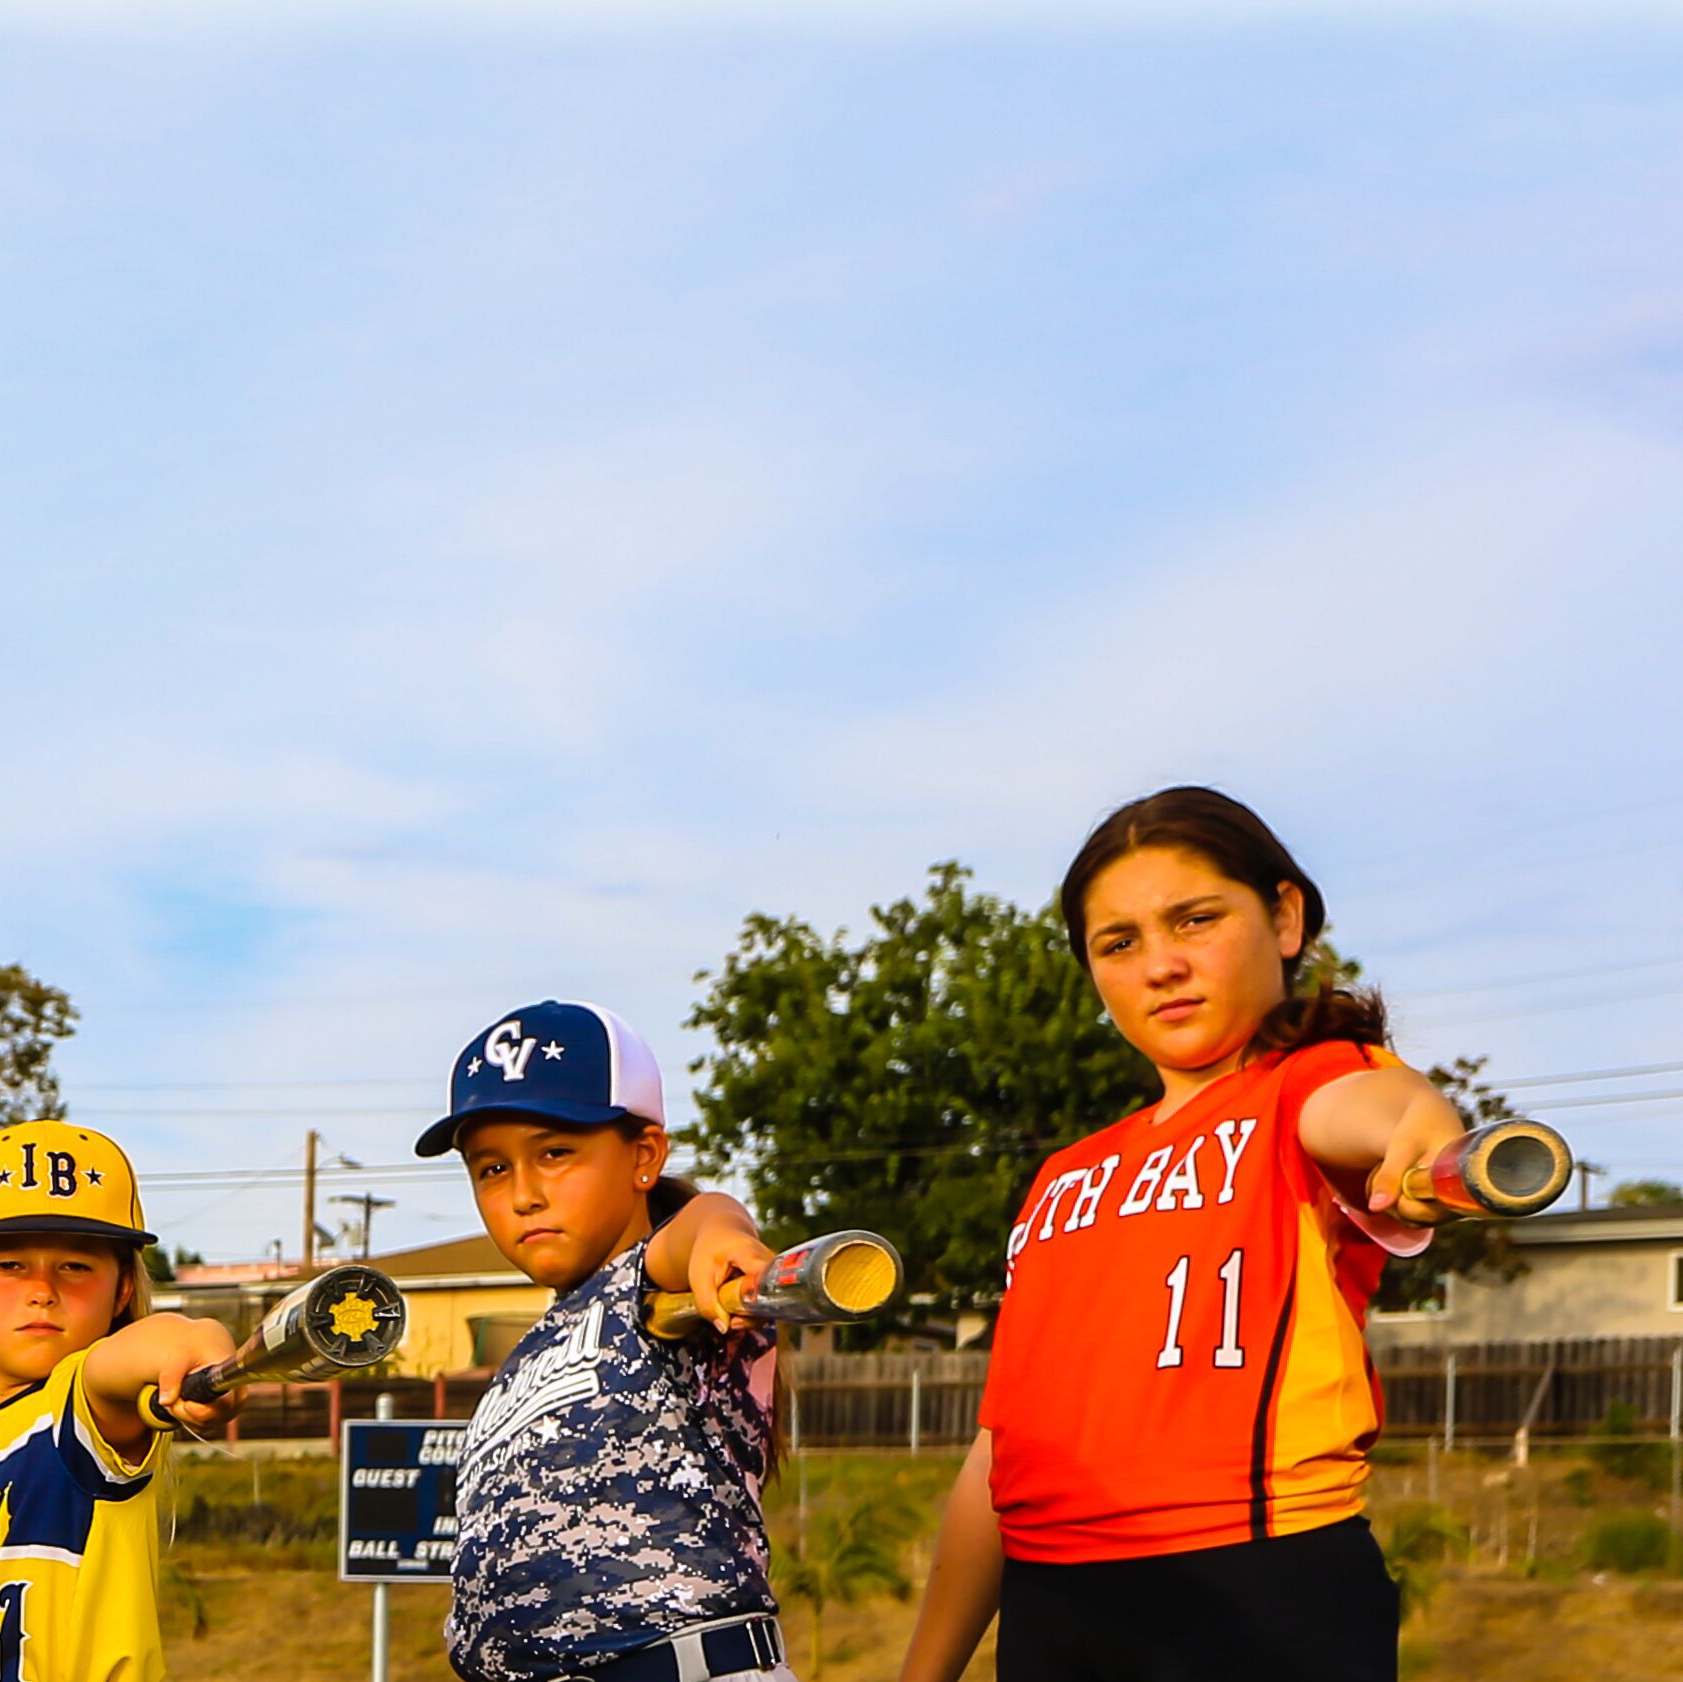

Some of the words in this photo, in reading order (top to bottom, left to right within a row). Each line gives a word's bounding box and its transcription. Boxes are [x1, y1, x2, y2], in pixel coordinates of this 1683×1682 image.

[485, 1019, 537, 1082] CV
[1118, 1118, 1258, 1217] BAY
[1156, 1249, 1245, 1369] 11
[423, 1430, 467, 1447] PITC
[418, 1446, 460, 1465] COU
[352, 1468, 422, 1488] GUEST
[348, 1540, 401, 1560] BALL
